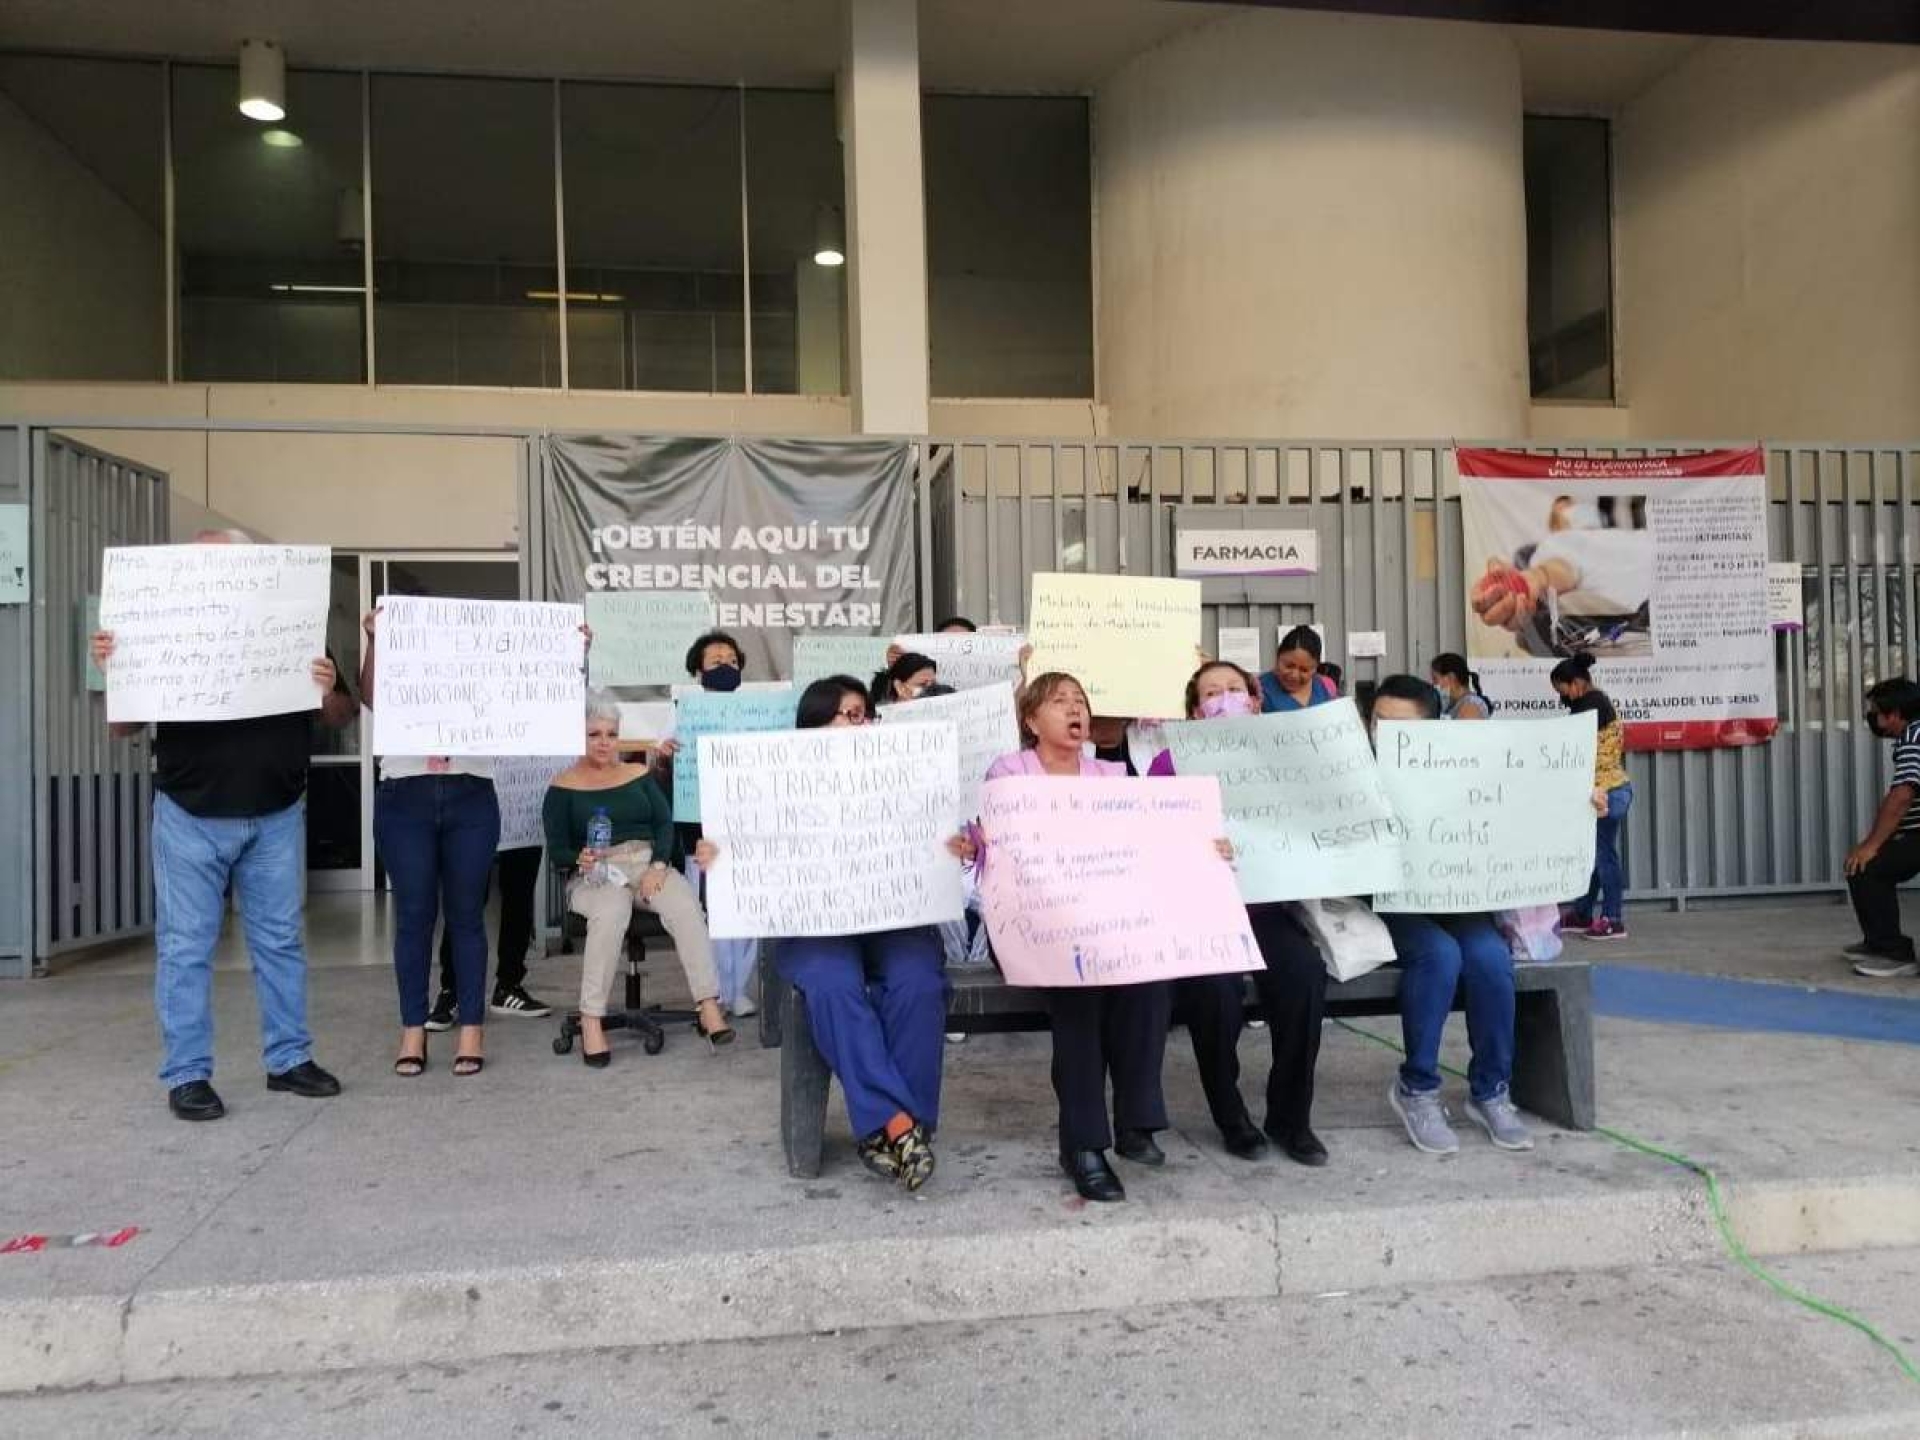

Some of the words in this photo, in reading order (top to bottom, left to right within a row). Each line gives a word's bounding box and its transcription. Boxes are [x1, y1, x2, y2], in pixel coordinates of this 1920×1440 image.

[592, 519, 720, 552] ¡OBTÉN
[732, 520, 818, 554] AQUÍ
[827, 525, 871, 551] TU
[1193, 545, 1299, 561] FARMACIA
[585, 562, 806, 589] CREDENCIAL
[817, 564, 881, 588] DEL
[1397, 731, 1481, 769] Pedimos
